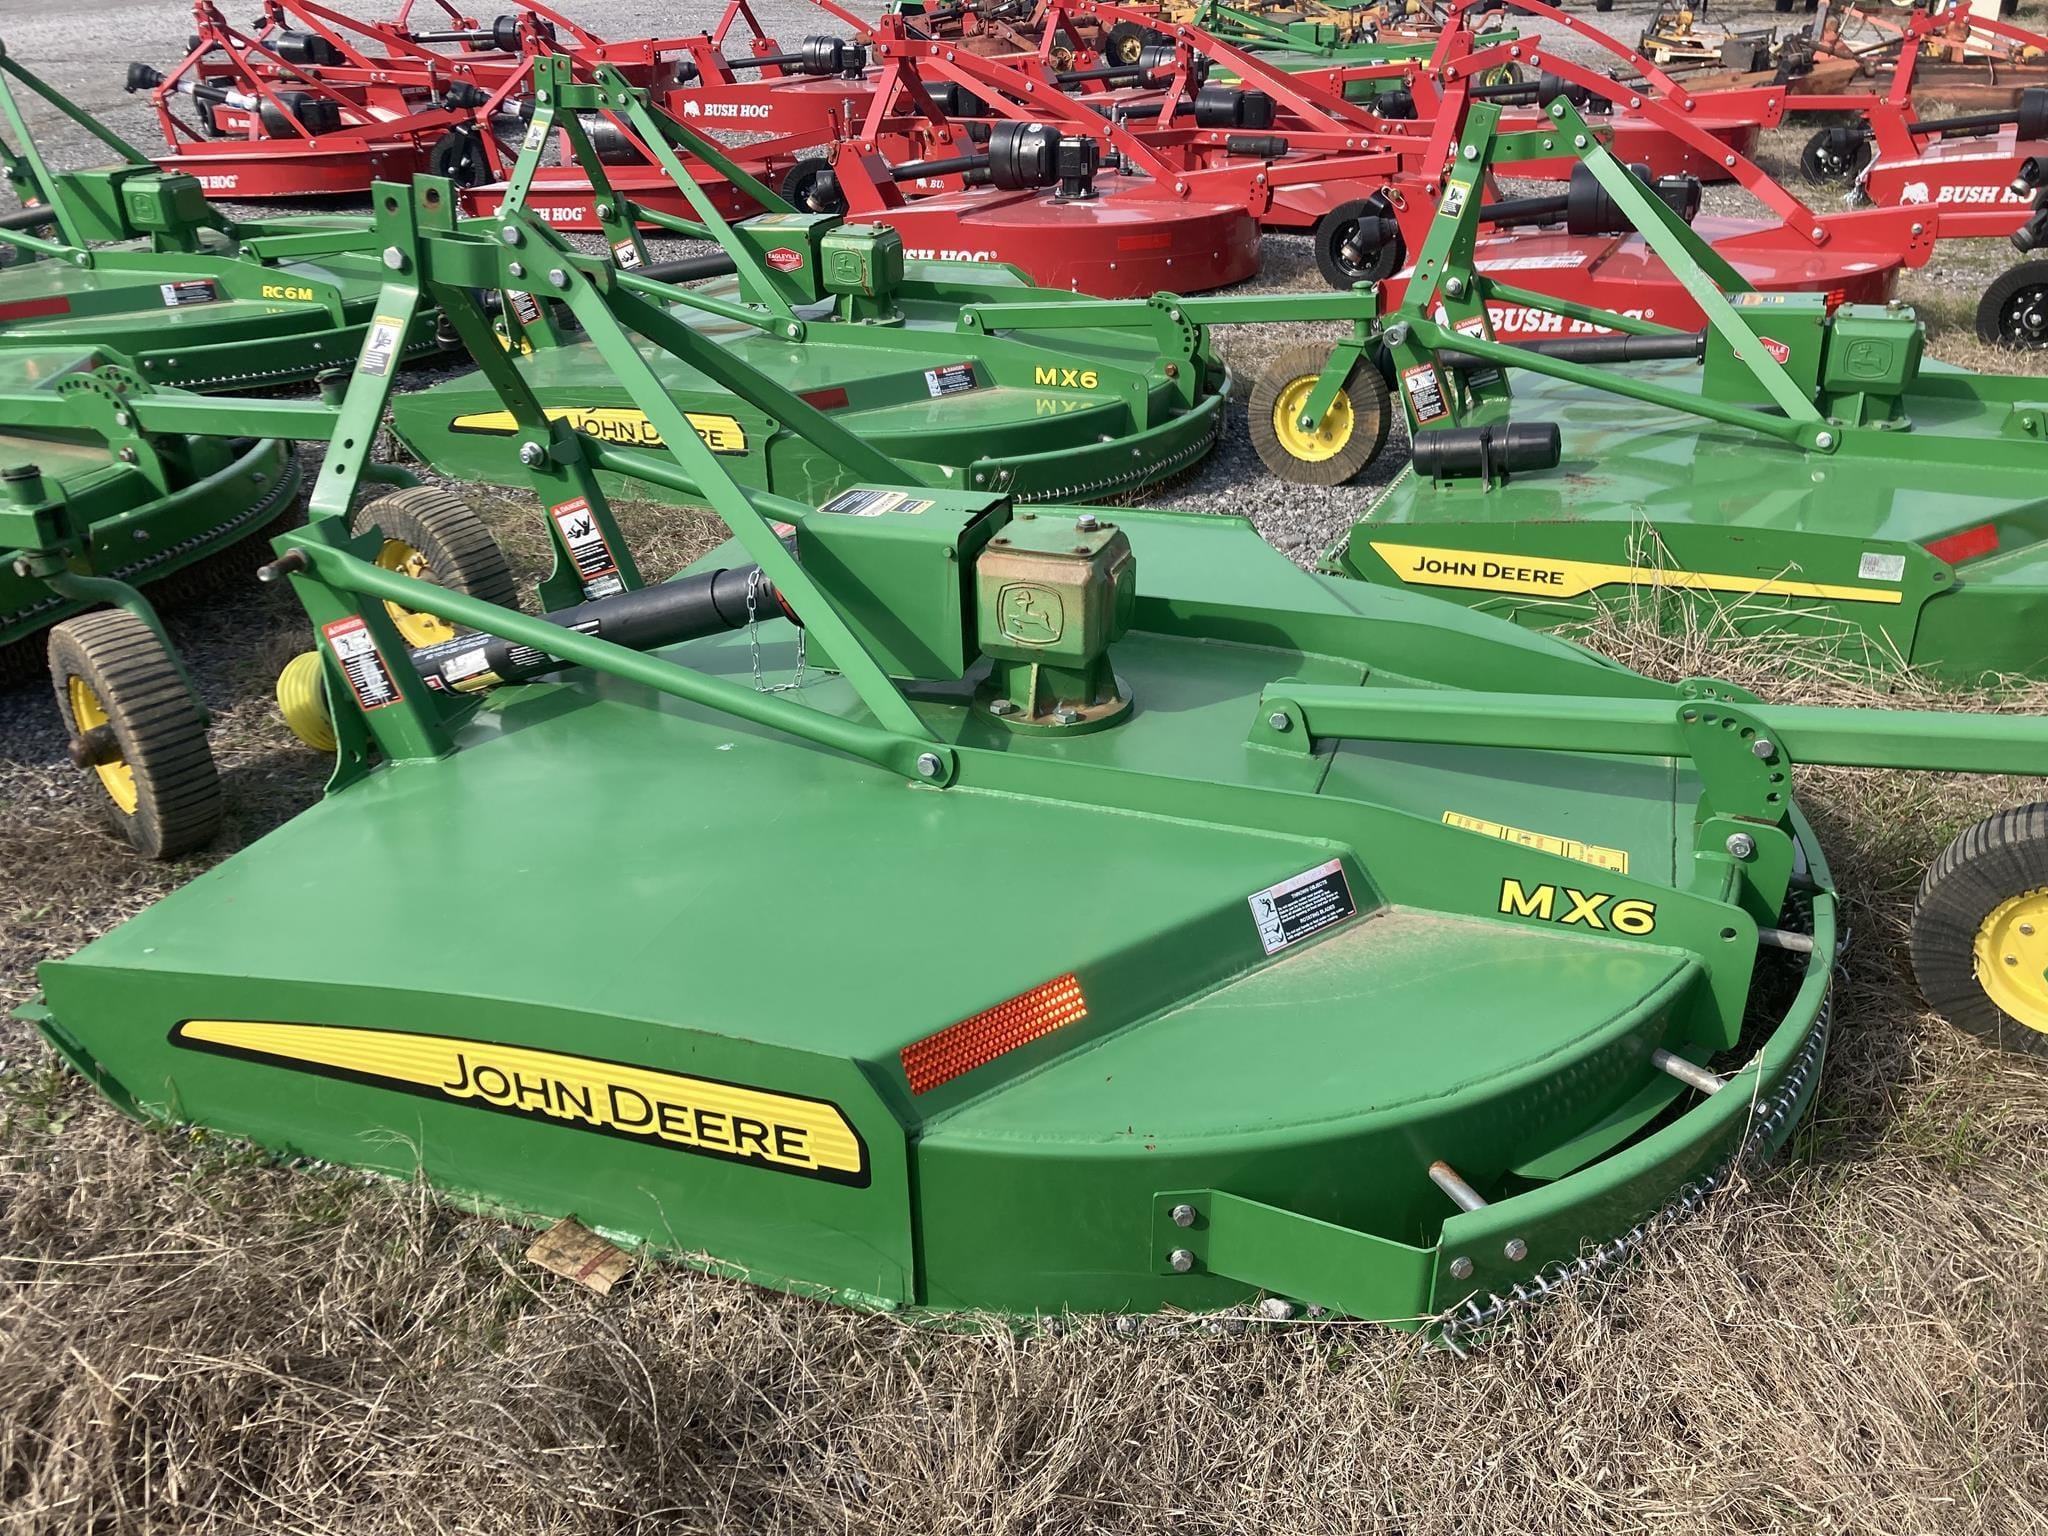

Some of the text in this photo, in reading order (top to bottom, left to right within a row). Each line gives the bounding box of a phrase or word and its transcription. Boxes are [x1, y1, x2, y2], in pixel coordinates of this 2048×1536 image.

[704, 104, 737, 116] BUSH
[1936, 186, 2000, 203] BUSH
[262, 285, 313, 301] RC6M
[1487, 307, 1564, 333] BUSH
[1035, 365, 1098, 390] MX6
[577, 414, 635, 440] JOHN
[1412, 556, 1564, 585] JOHN DEERE
[1497, 877, 1658, 936] MX6
[444, 1054, 811, 1162] JOHN DEERE
